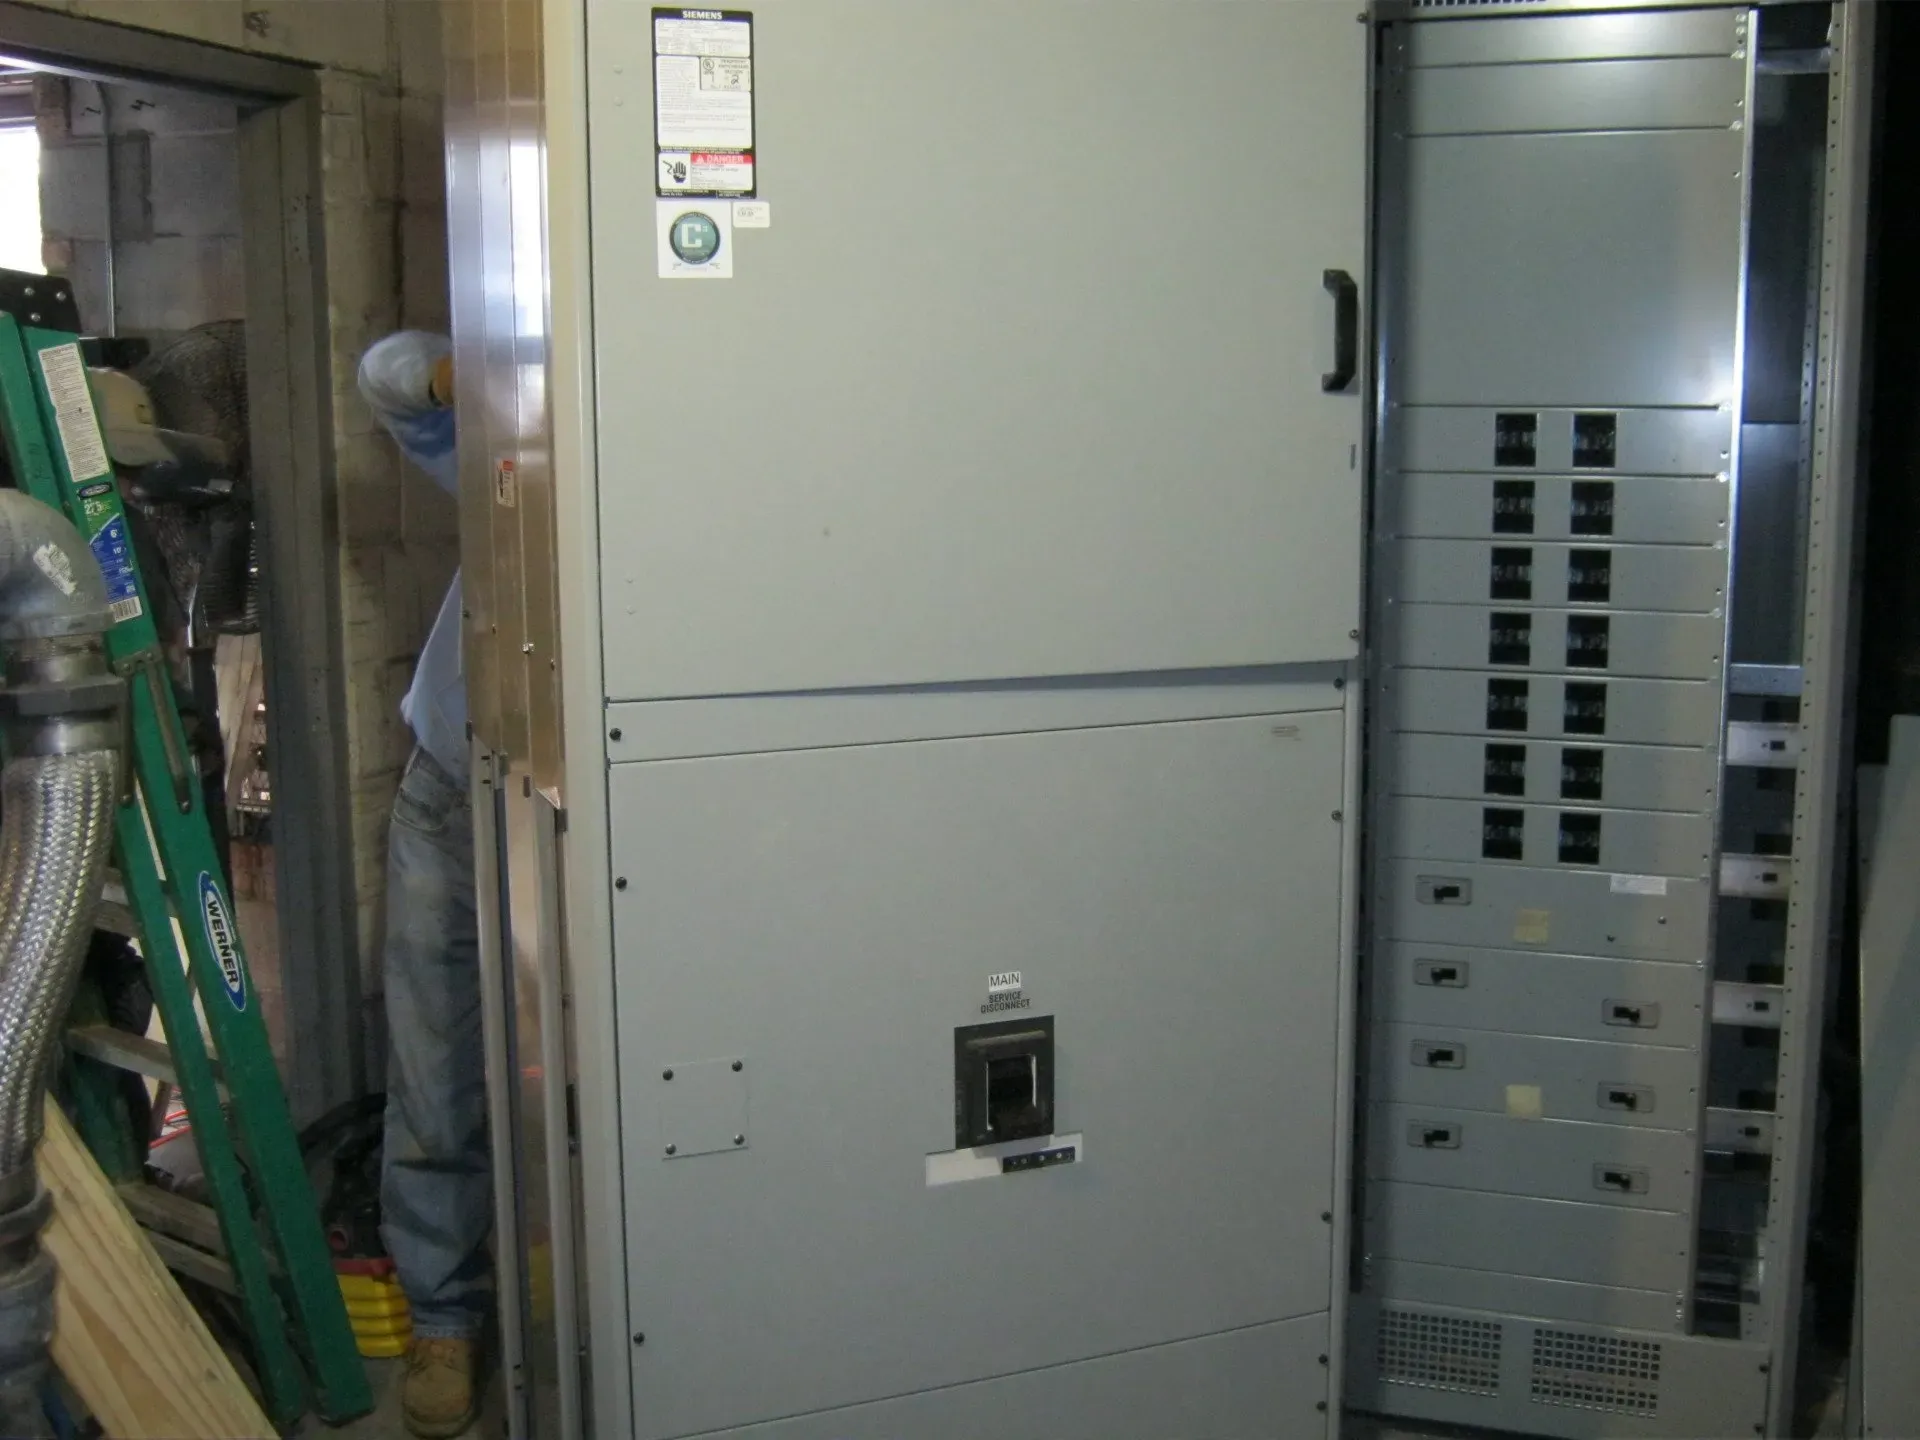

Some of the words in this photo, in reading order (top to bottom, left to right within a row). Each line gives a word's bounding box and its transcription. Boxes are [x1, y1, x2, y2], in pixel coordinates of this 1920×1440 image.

[682, 10, 723, 20] SIEMENS
[706, 154, 744, 165] DANGER
[207, 899, 239, 984] WERNER
[990, 973, 1020, 987] MAIN
[988, 991, 1022, 1004] SERVICE
[980, 998, 1030, 1014] DISCONNECT
